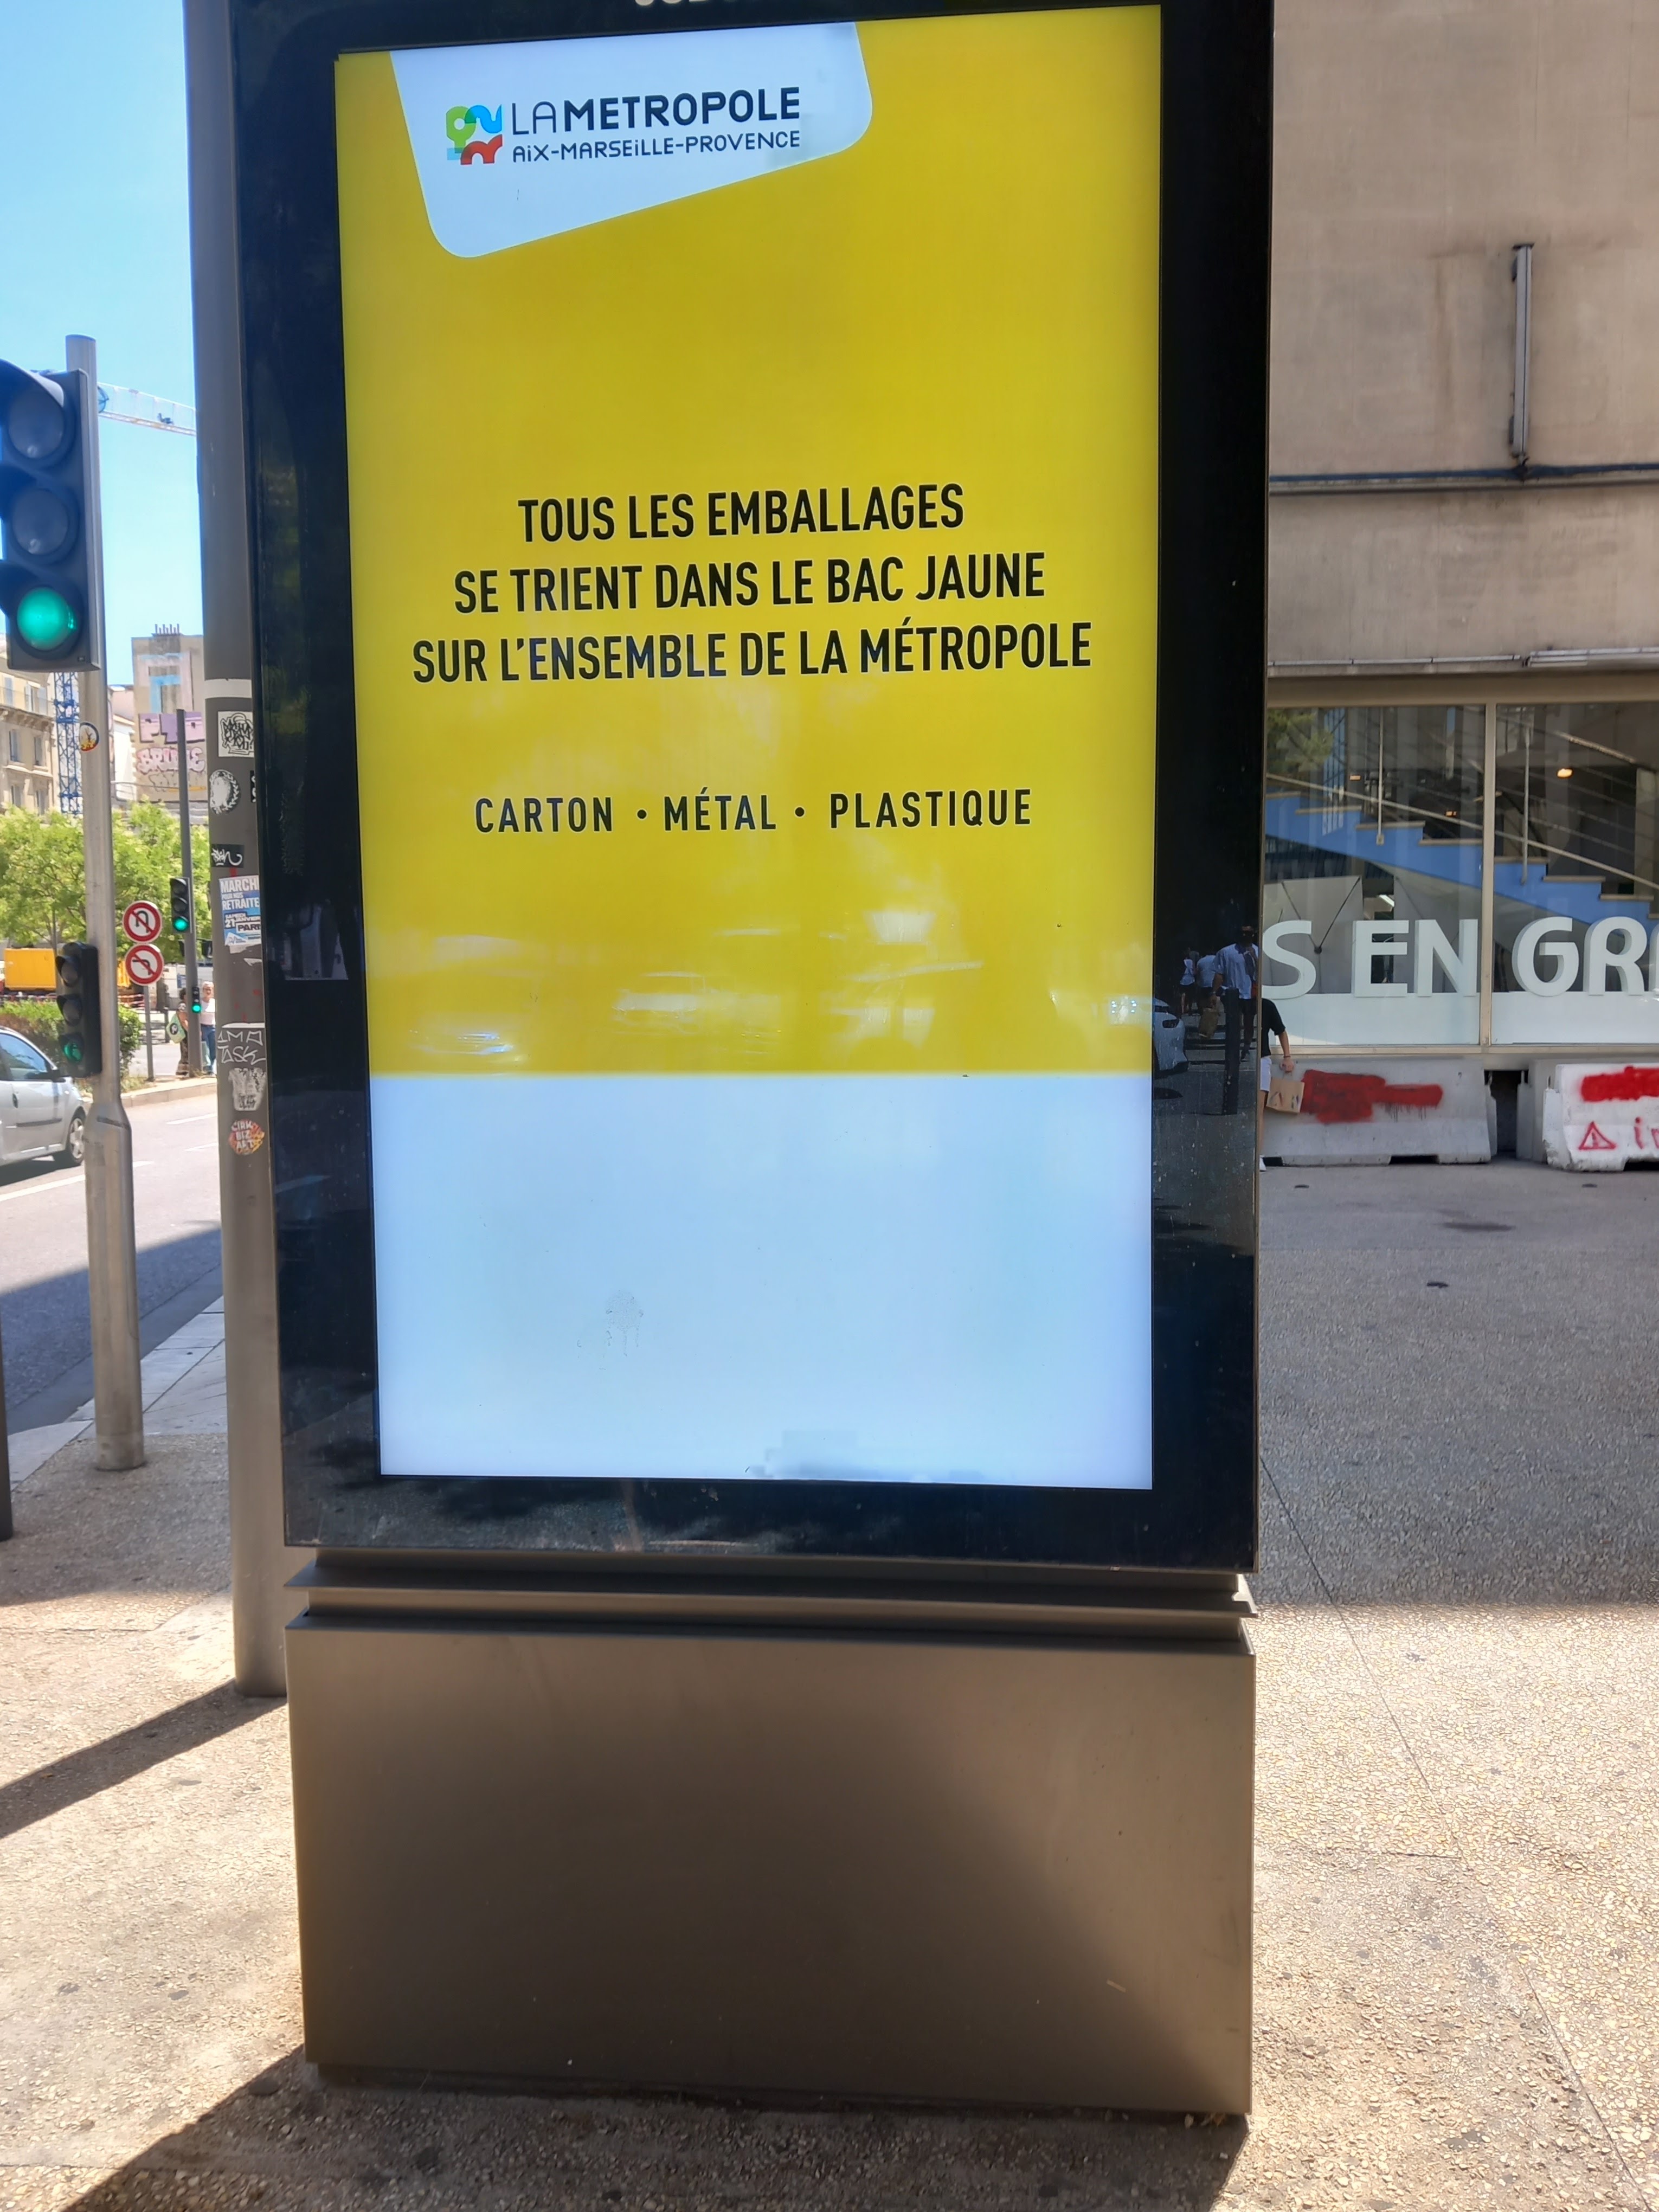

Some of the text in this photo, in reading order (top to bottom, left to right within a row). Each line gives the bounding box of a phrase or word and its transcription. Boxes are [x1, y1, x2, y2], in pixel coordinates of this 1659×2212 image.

[518, 484, 963, 542] TOUS LES EMBALLAGES
[455, 552, 1045, 613] SE TRIENT DANS LE BAC JAUNE
[414, 616, 1091, 683] SUR L'ENSEMBLE DE LA MÉTROPOLE
[476, 787, 1031, 833] CARTON MÉTAL PLASTIQUE
[225, 918, 235, 928] 21
[1352, 919, 1478, 998] EN
[1512, 916, 1659, 998] GR
